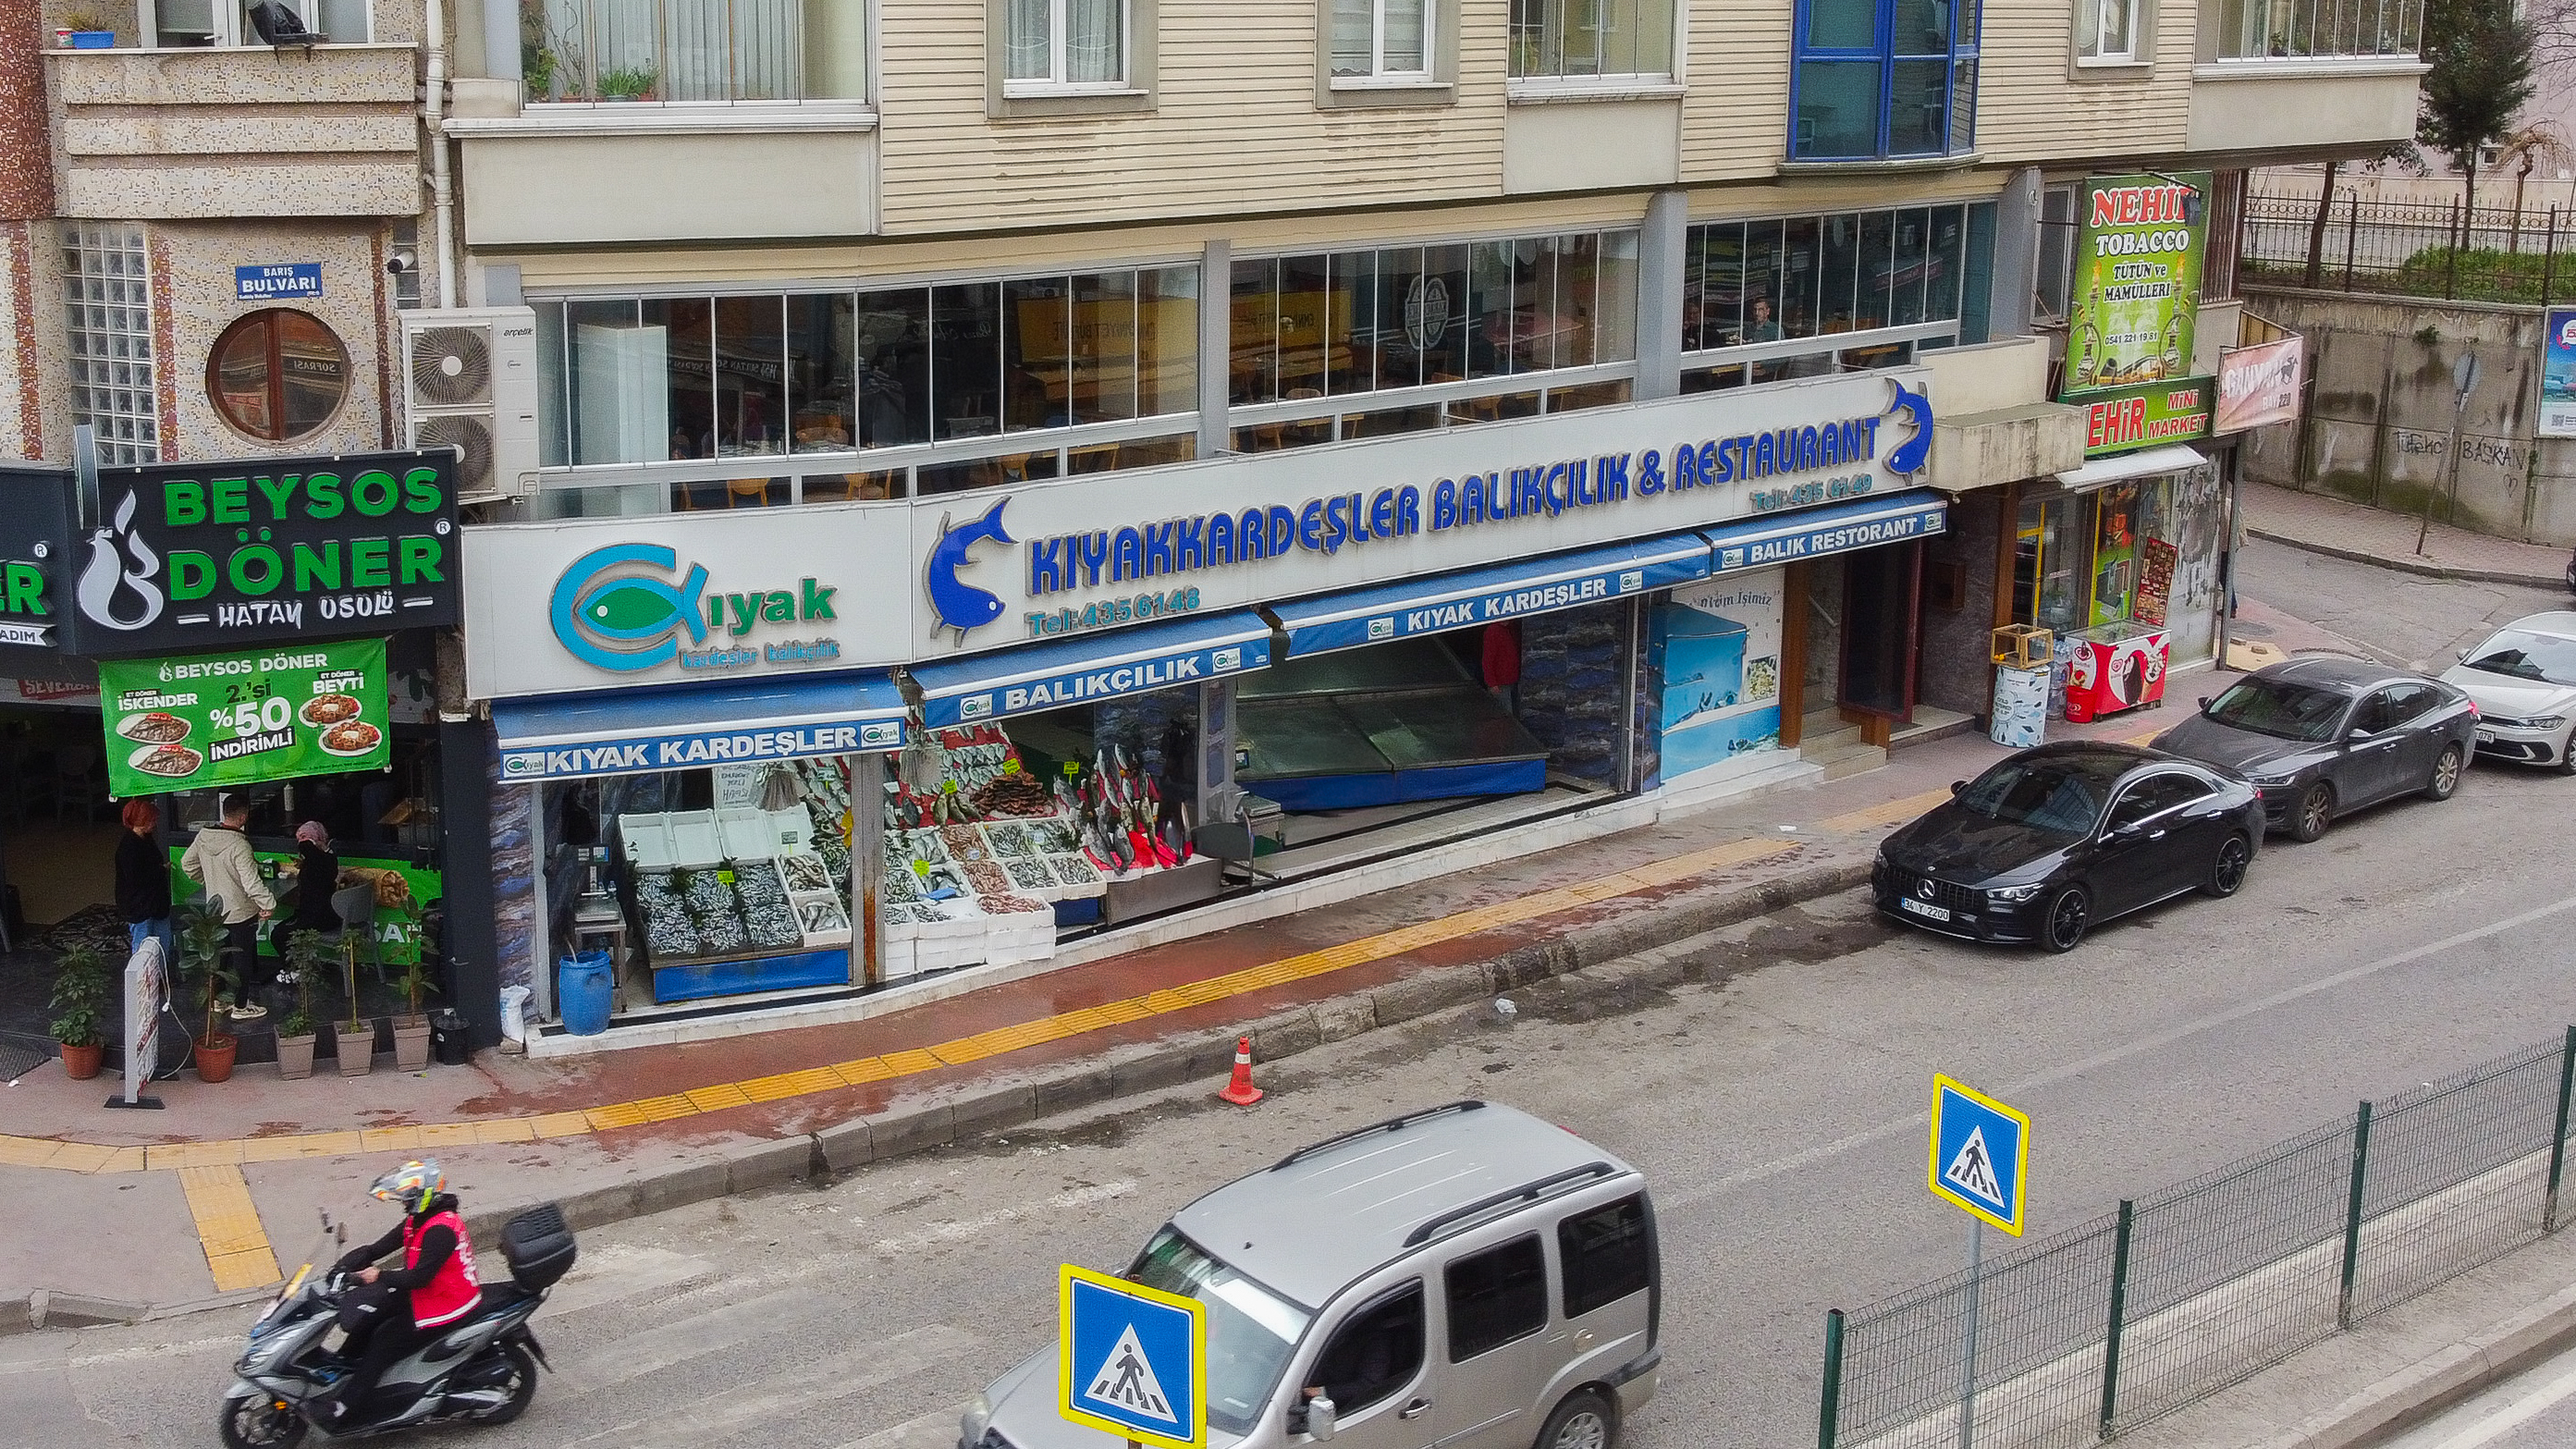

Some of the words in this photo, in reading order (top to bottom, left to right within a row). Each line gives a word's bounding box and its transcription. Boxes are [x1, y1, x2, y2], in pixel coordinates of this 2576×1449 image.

[2095, 228, 2190, 257] TOBACCO
[242, 276, 316, 293] BULVARI
[264, 267, 294, 277] BARIŞ
[2154, 265, 2167, 276] ve
[2147, 412, 2208, 440] MARKET
[1427, 452, 1631, 532] BALIKÇILIK
[1634, 448, 1666, 497] &
[1671, 416, 1881, 492] RESTAURANT
[163, 467, 442, 525] BEYSOS
[1750, 536, 1806, 563] BALIK
[1811, 517, 1918, 552] RESTORANT
[167, 527, 445, 601] DÖNER
[0, 562, 47, 615] R
[218, 602, 302, 629] HATAY
[1407, 602, 1474, 632] KIYAK
[1485, 578, 1607, 618] KARDEŞLER
[175, 660, 253, 680] BEYSOS
[259, 653, 328, 673] DÖNER
[313, 672, 364, 695] BEYTİ
[1005, 656, 1200, 712] BALIKÇILIK
[118, 694, 199, 712] İSKENDER
[210, 696, 292, 737] %50
[211, 730, 293, 762] İNDİRİMLİ
[546, 743, 650, 773] KIYAK
[659, 727, 858, 765] KARDEŞLER
[1918, 903, 1924, 914] Y
[1927, 906, 1949, 920] 2200
